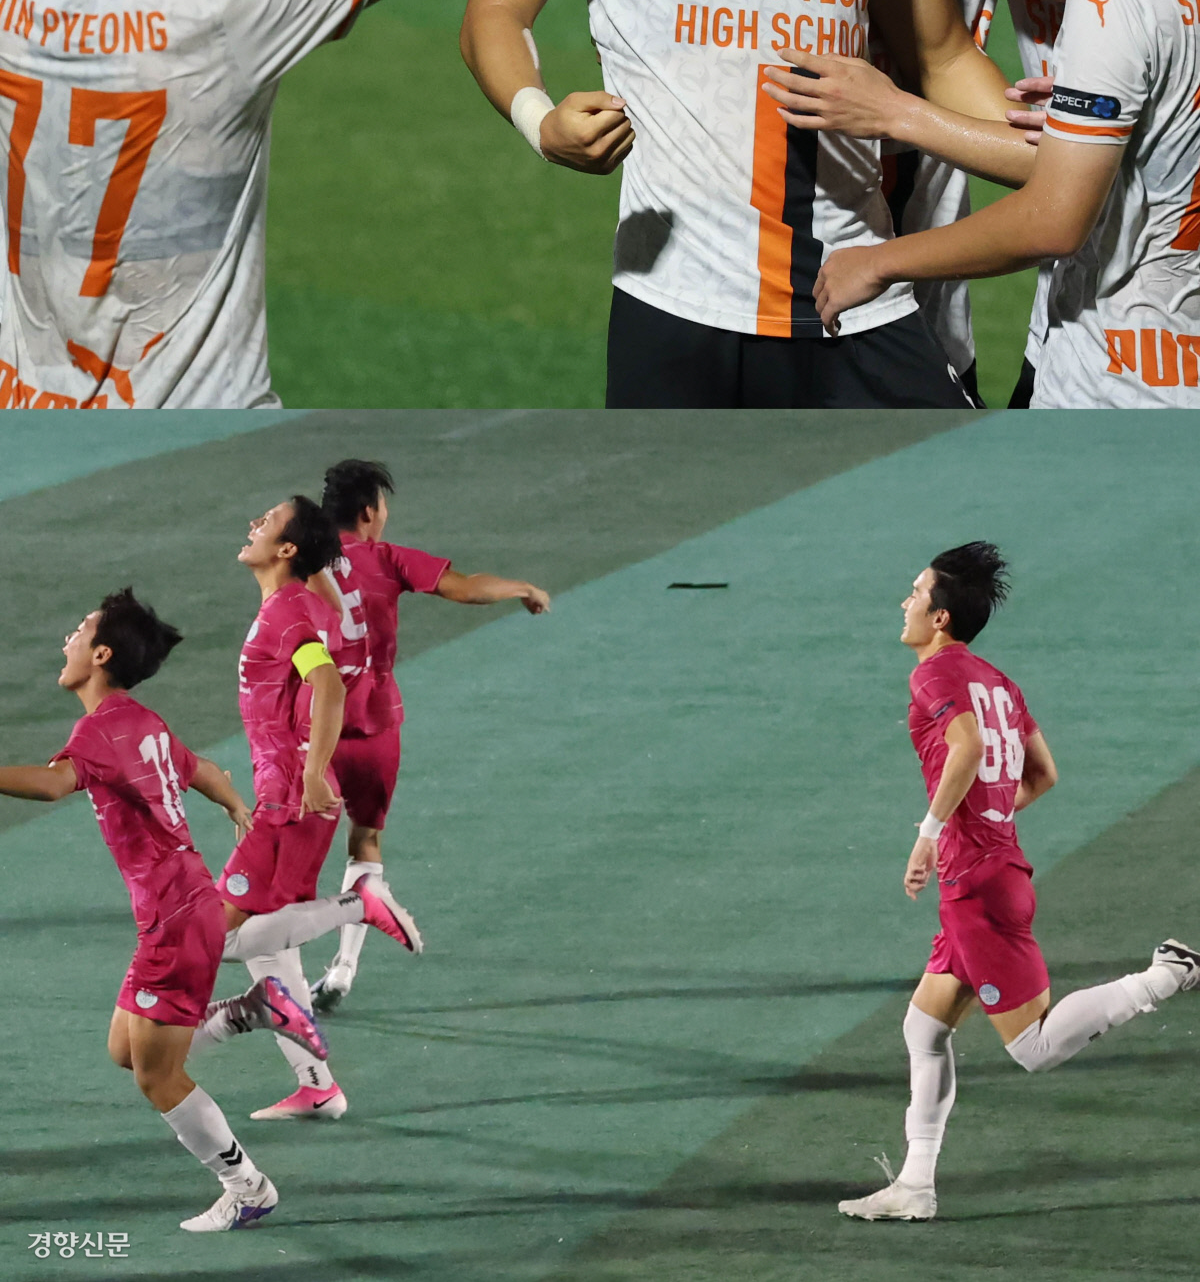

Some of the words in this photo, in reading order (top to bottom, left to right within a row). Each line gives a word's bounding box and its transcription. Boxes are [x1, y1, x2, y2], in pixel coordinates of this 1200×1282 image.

[40, 7, 168, 55] PYEONG
[675, 3, 759, 50] HIGH
[1053, 92, 1092, 109] SPECT
[968, 682, 1025, 783] 66
